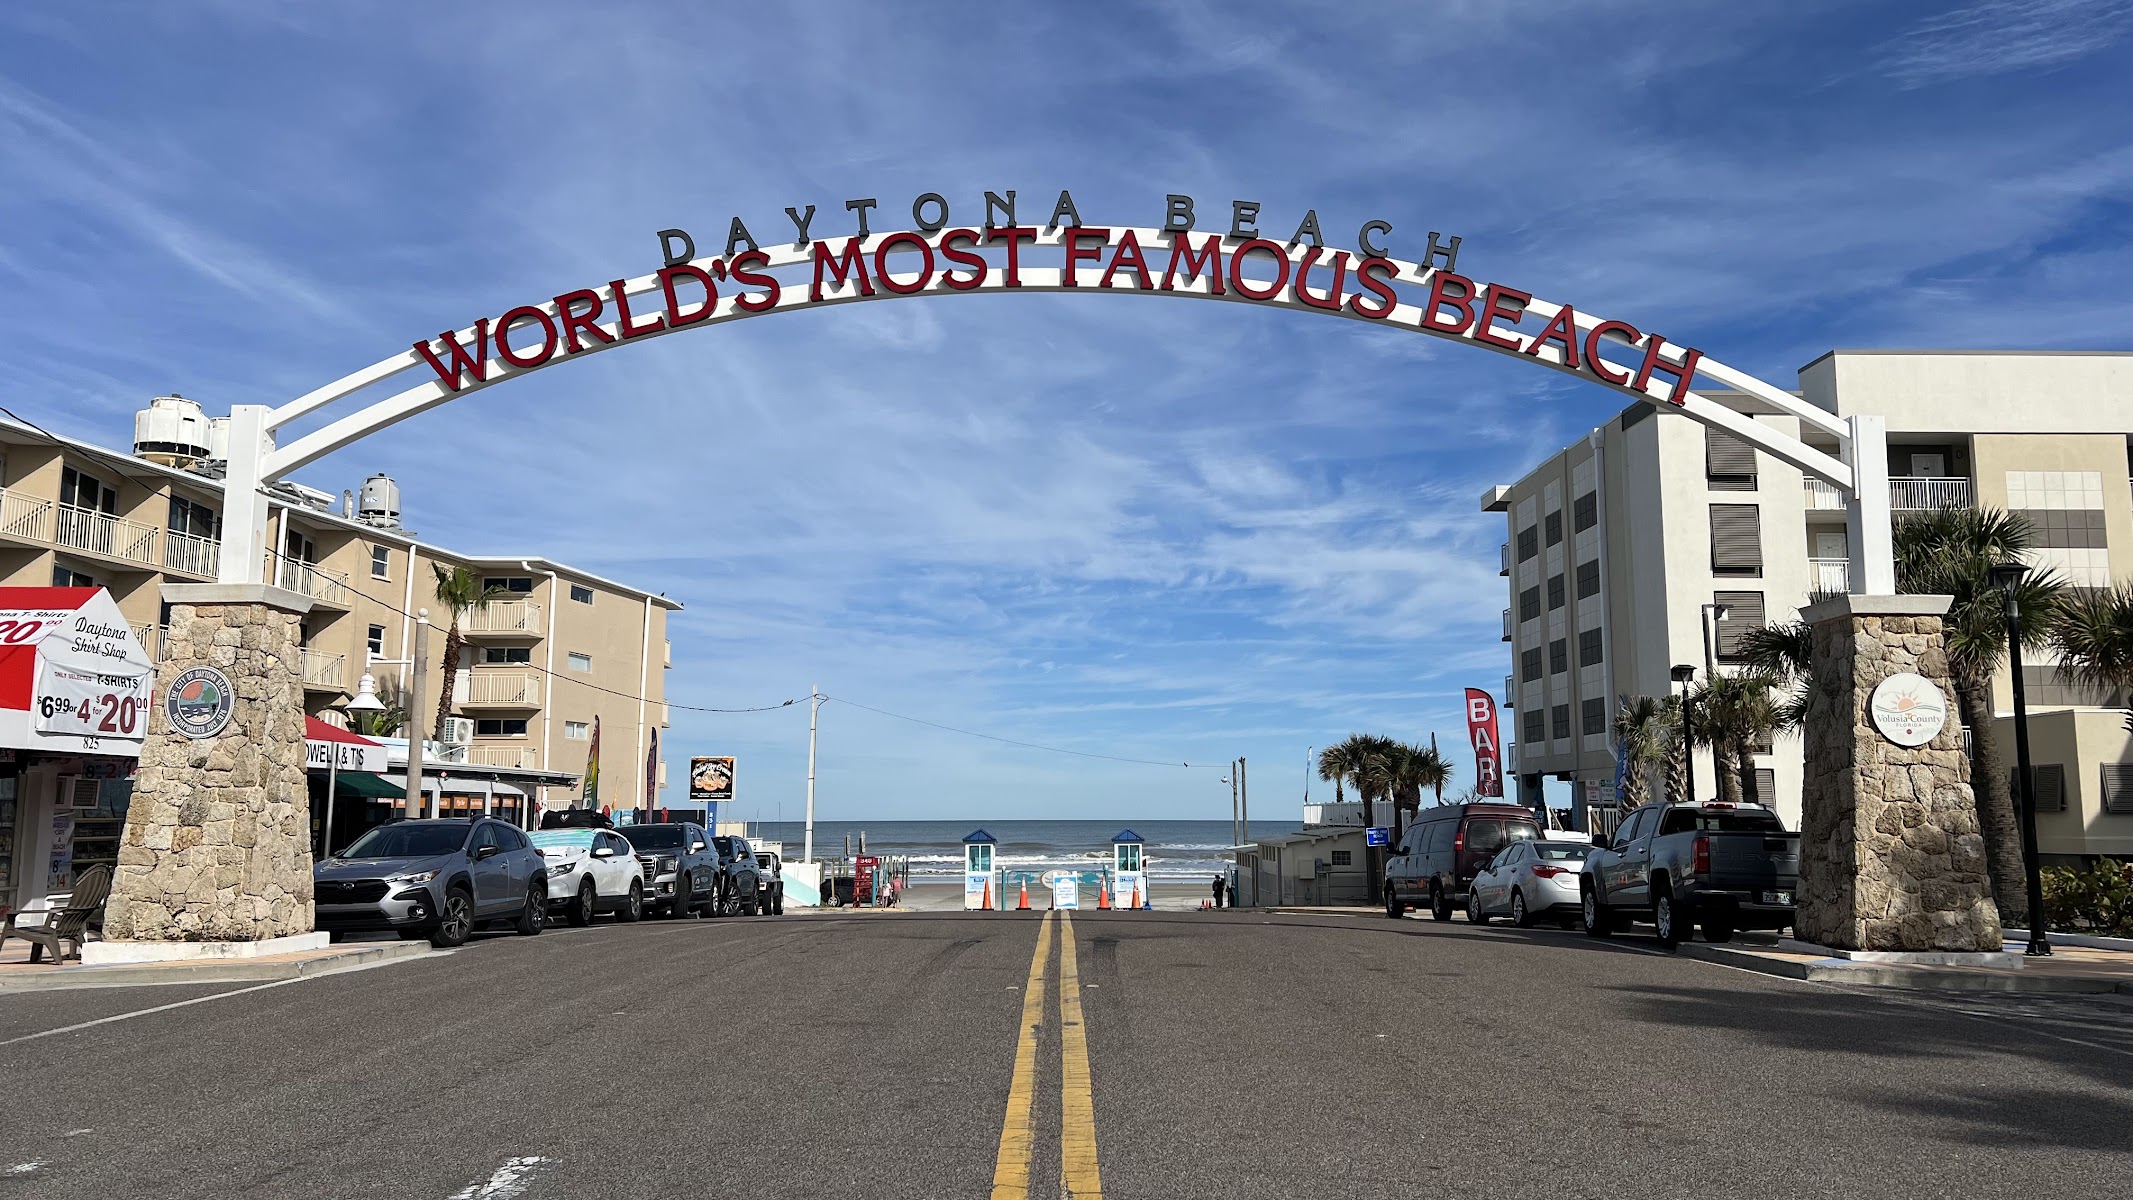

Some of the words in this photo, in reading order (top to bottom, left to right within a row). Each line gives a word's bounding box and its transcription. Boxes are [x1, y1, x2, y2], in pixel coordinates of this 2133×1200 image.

[657, 190, 1082, 267] DAYTONA
[1164, 194, 1462, 273] BEACH
[413, 251, 781, 392] WORLD'S
[810, 227, 1037, 301] MOST
[1063, 226, 1399, 319] FAMOUS
[1421, 270, 1704, 406] BEACH
[75, 616, 126, 640] Daytona
[71, 637, 101, 655] Shirt
[101, 642, 127, 662] Shop
[54, 671, 67, 679] ONLY
[97, 674, 138, 689] T-SHIRTS
[170, 689, 179, 701] THE
[175, 677, 187, 690] CITY
[186, 671, 194, 680] OF
[195, 670, 218, 682] DAYTONA
[215, 679, 229, 697] BEACH
[69, 705, 77, 713] or
[77, 698, 90, 723] 4
[92, 706, 102, 715] for
[172, 711, 205, 733] INCORPORATED
[206, 720, 218, 731] JULY
[1876, 714, 1908, 723] Volusia
[1910, 714, 1942, 725] County
[83, 736, 99, 749] 825
[1470, 697, 1498, 781] BAR
[306, 743, 338, 764] WEL
[341, 746, 348, 765] &
[351, 747, 364, 766] T'S
